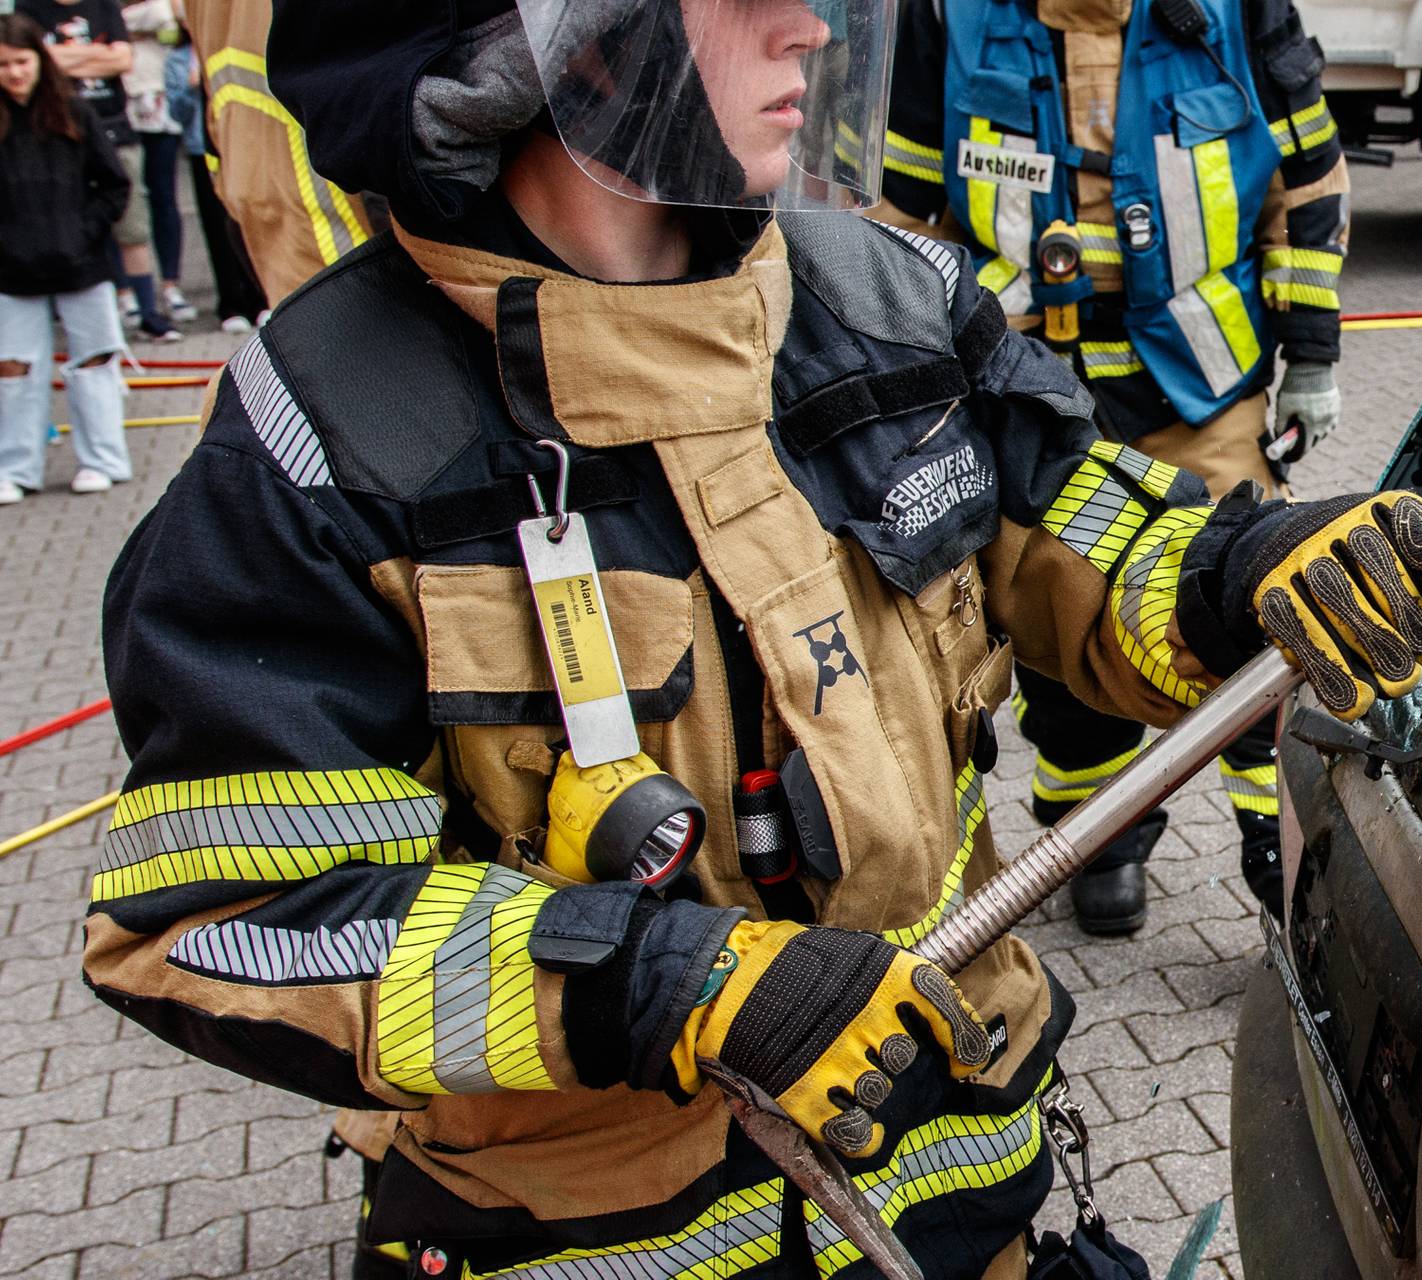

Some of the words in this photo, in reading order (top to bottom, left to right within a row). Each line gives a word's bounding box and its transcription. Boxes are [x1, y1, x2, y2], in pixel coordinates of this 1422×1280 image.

[963, 151, 1048, 183] Ausbilder
[881, 445, 976, 521] FEUERWEHR
[578, 578, 598, 616] Aland
